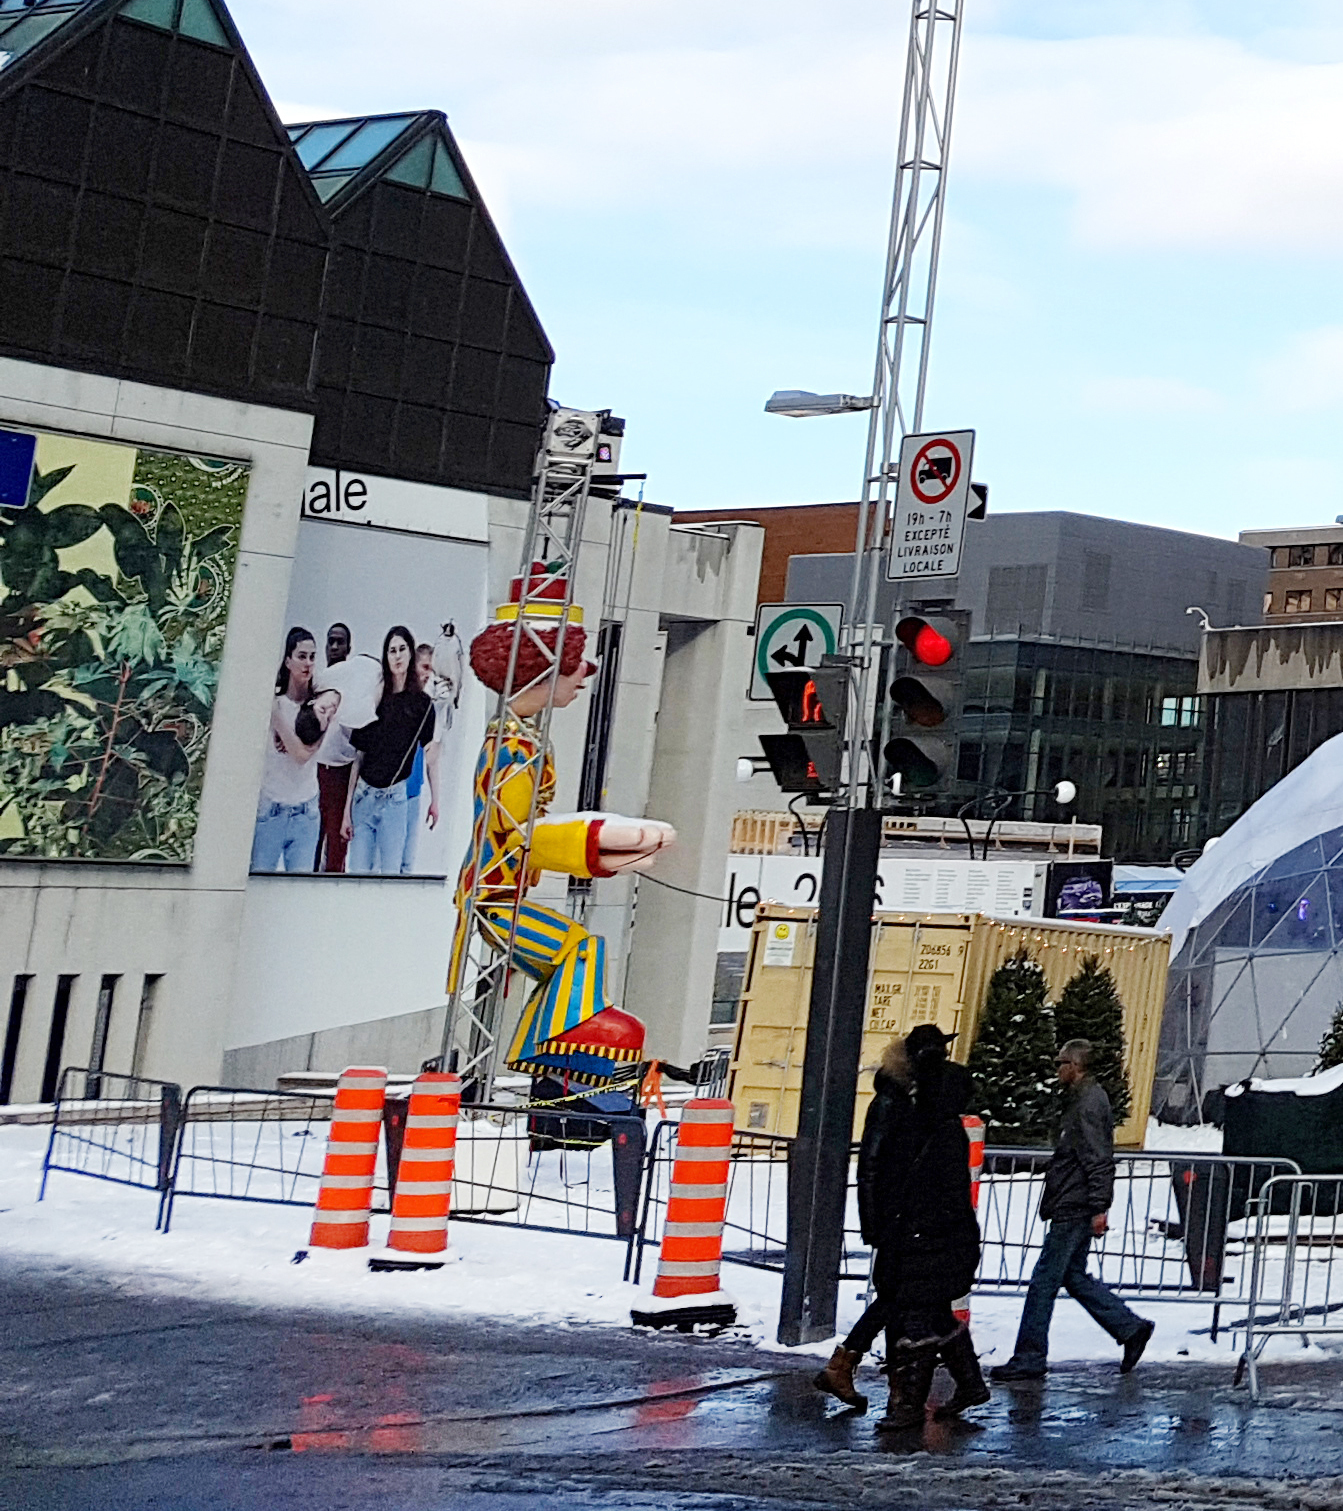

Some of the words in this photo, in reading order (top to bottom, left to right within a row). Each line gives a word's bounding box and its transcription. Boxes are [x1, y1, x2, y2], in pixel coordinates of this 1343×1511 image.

[906, 512, 925, 526] 19h
[939, 509, 952, 523] 7h
[904, 524, 951, 542] EXCEPTÉ
[897, 543, 954, 558] LIVRAISON
[903, 559, 944, 573] LOCALE
